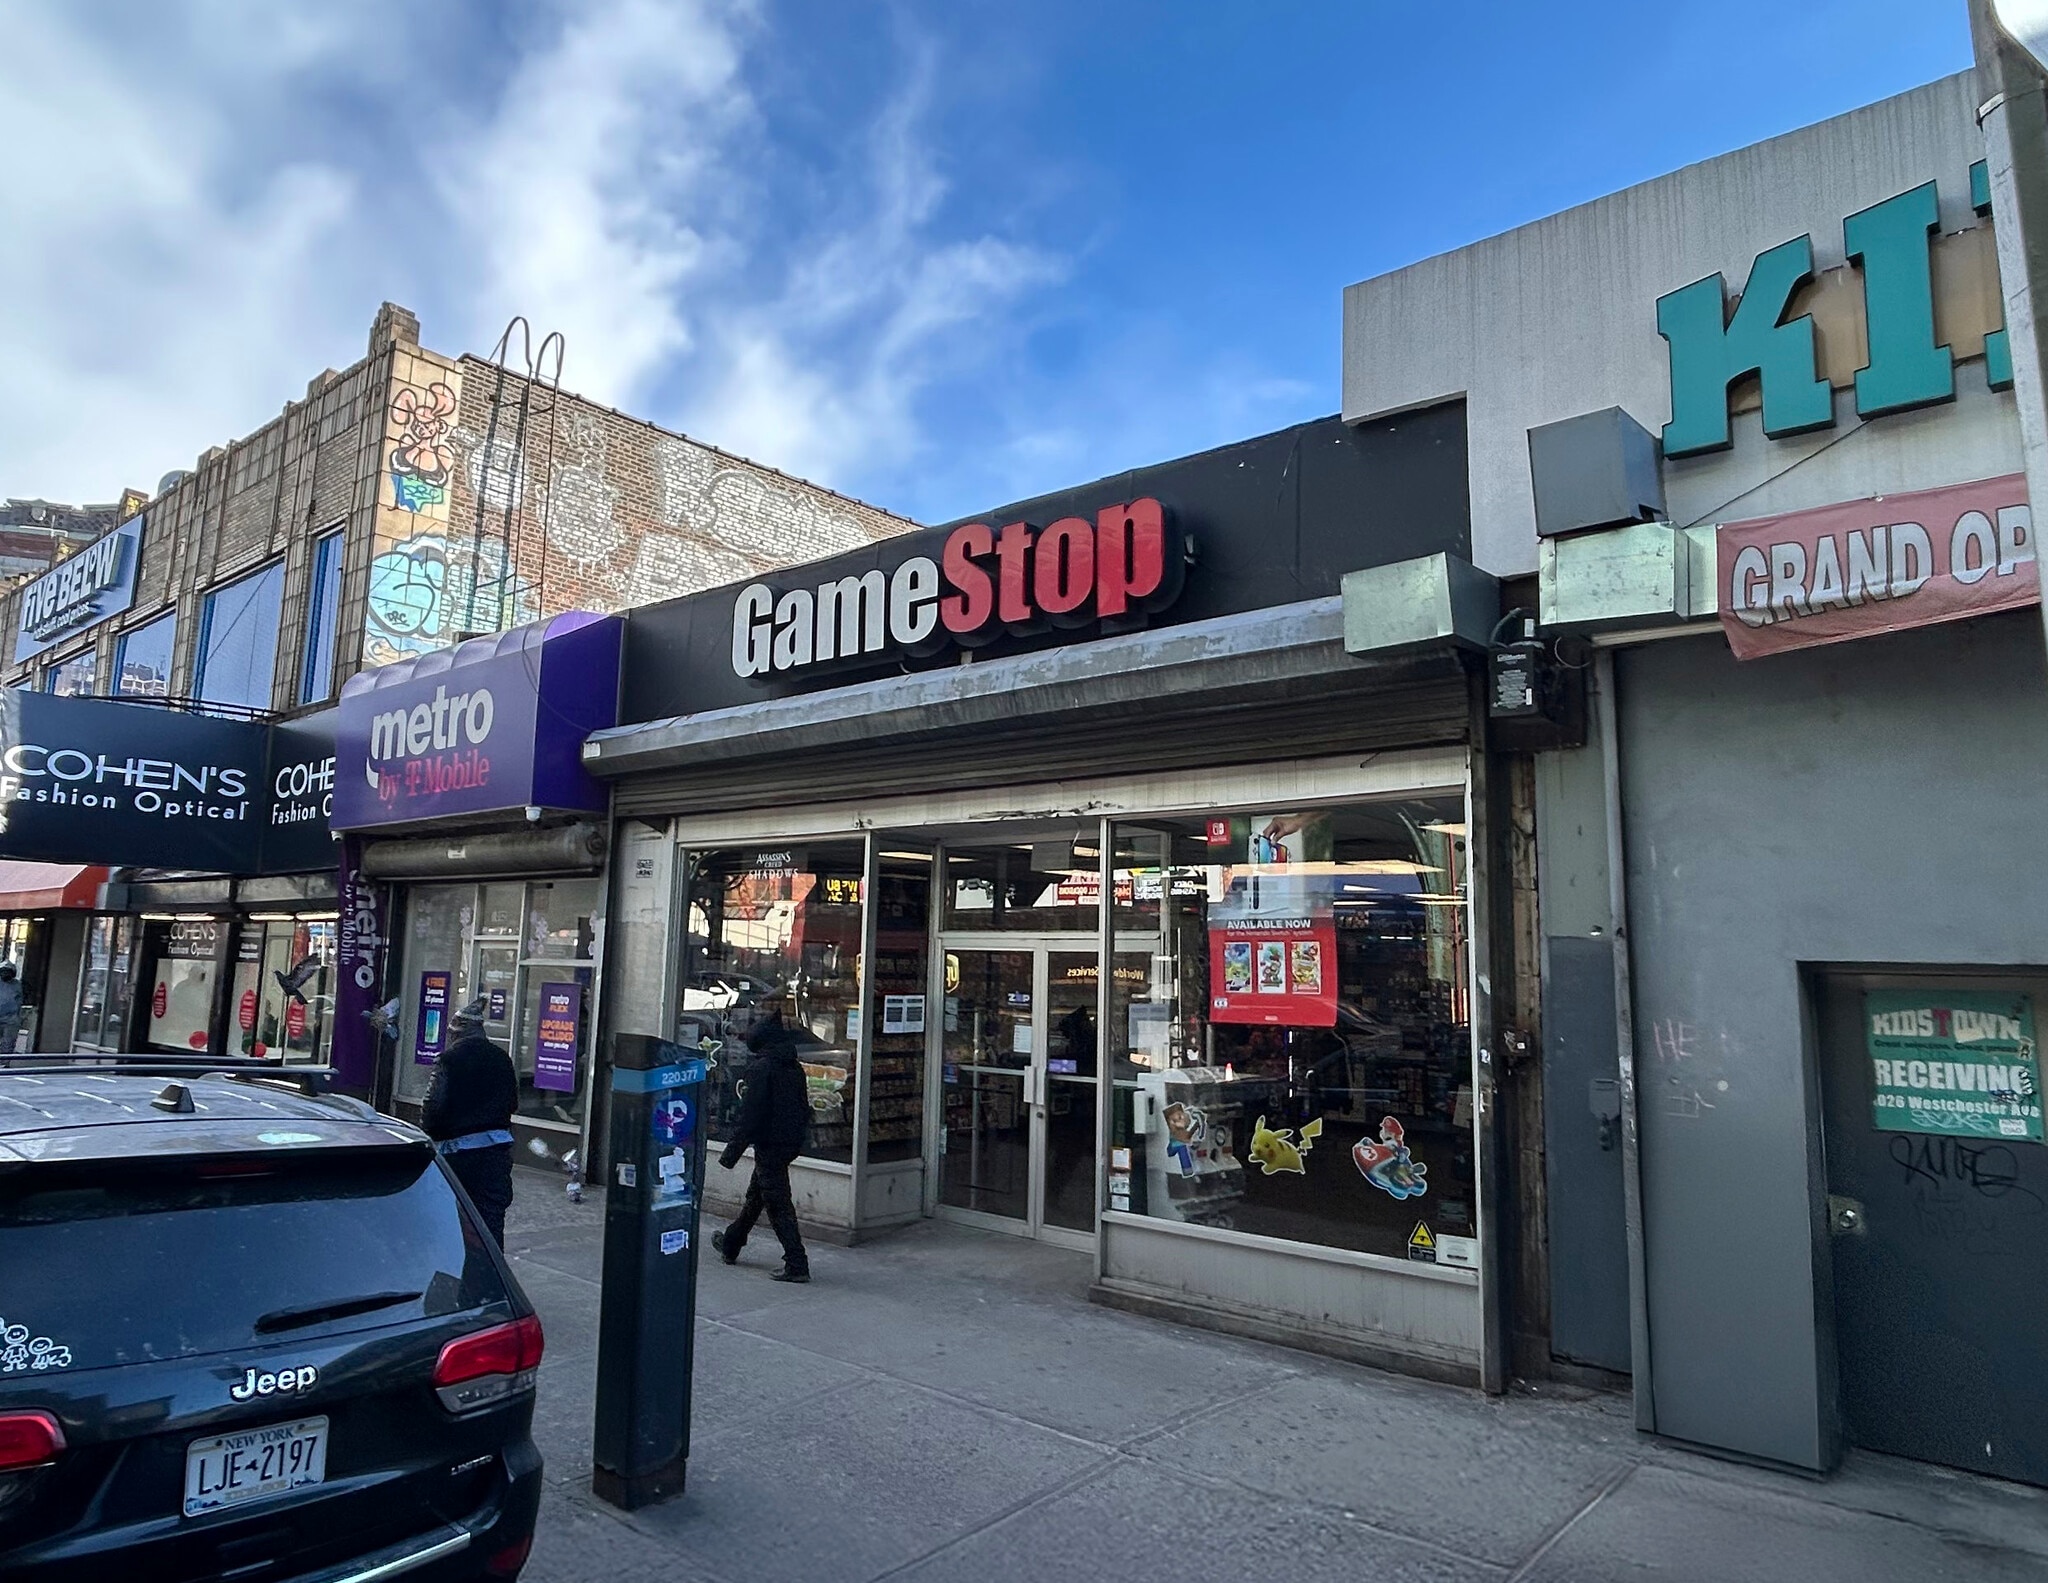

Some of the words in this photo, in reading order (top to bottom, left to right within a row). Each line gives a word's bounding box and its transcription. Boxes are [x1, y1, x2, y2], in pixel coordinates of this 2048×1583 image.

[1656, 157, 2014, 460] KI
[731, 496, 1165, 679] GameStop
[1731, 520, 1933, 629] GRAND
[370, 684, 494, 761] metro
[4, 744, 247, 798] COHEN'S
[0, 775, 117, 809] Fashion
[134, 791, 247, 821] Optical
[271, 800, 316, 825] Fashion
[749, 868, 800, 880] SHADOWS
[1226, 919, 1283, 930] AVAILABLE
[1285, 918, 1311, 929] NOW
[661, 1068, 699, 1084] 220377
[1873, 1094, 1905, 1109] 026
[1908, 1096, 2007, 1116] Westchester
[231, 1365, 317, 1399] Jeep
[225, 1435, 258, 1451] NEW
[259, 1426, 295, 1444] YORK
